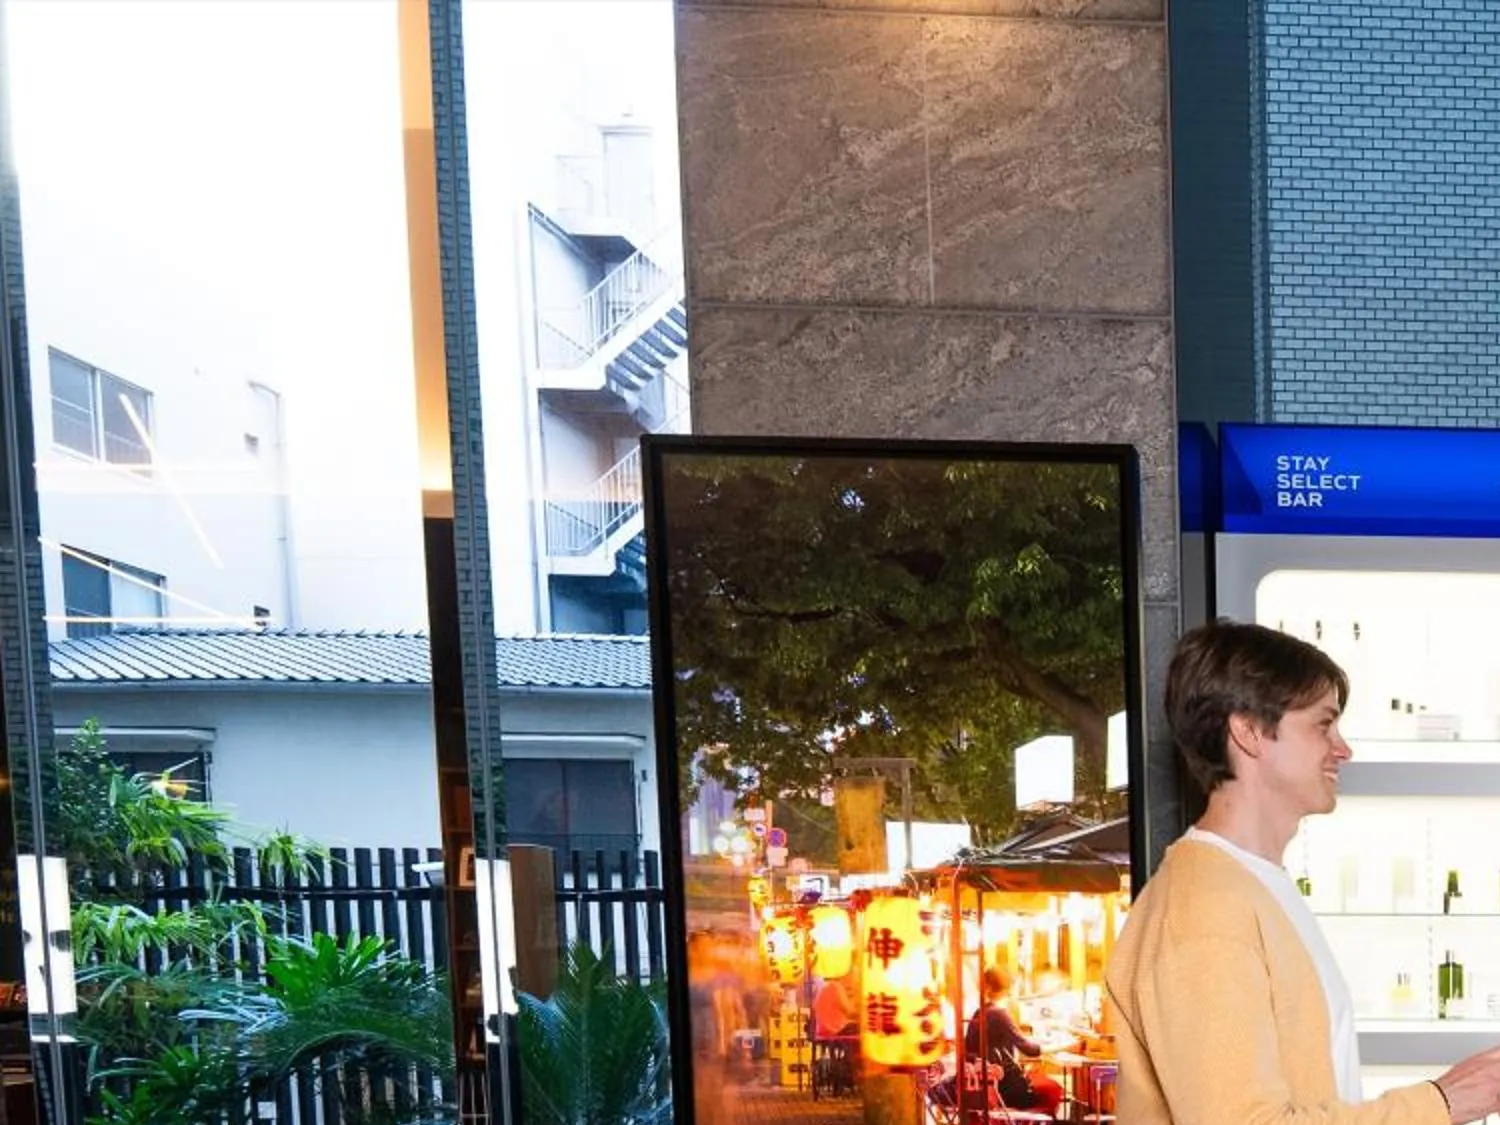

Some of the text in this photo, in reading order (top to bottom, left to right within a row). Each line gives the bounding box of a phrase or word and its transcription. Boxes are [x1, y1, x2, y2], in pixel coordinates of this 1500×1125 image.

[1276, 455, 1331, 471] STAY
[1276, 473, 1361, 490] SELECT
[1277, 492, 1323, 507] BAR
